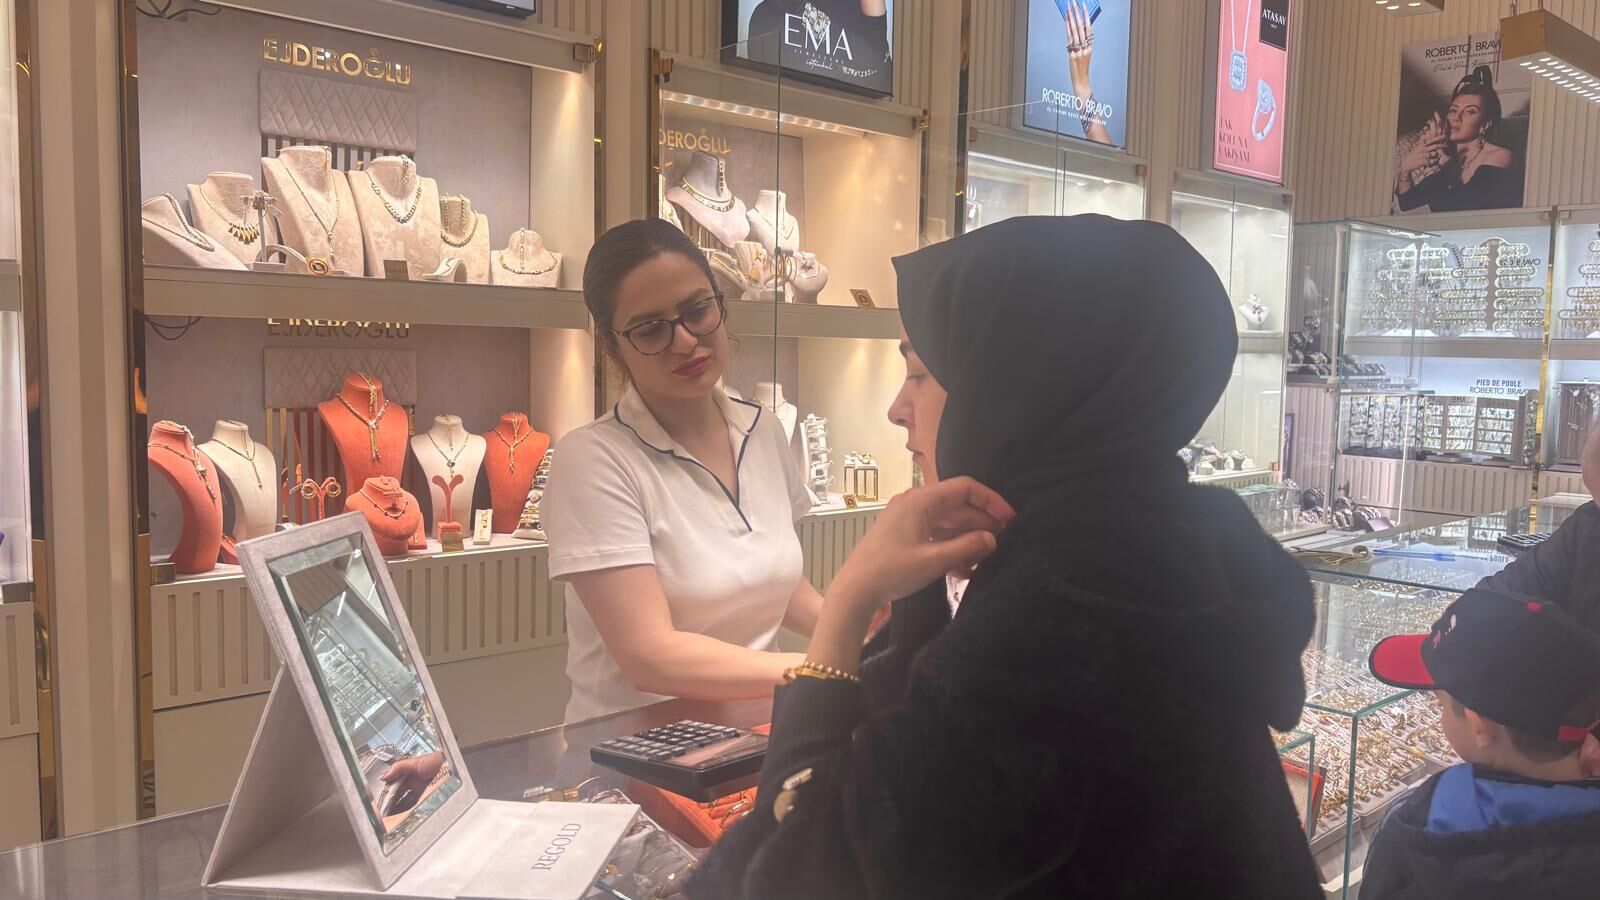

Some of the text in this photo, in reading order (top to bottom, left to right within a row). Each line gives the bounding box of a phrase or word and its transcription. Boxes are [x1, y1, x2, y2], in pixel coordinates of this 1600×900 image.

[1262, 8, 1287, 26] ATASAY
[784, 13, 853, 61] EMA
[1425, 43, 1471, 59] ROBERTO
[263, 37, 411, 85] EJDEROĞLU
[1042, 87, 1083, 111] ROBERTO
[1085, 96, 1113, 118] BRAVO
[1219, 116, 1233, 131] TAK
[1219, 131, 1248, 149] KOLUNA
[1469, 386, 1504, 395] ROBERTO
[1492, 379, 1500, 387] DE
[1501, 380, 1522, 388] POULE
[531, 823, 581, 870] REGOLD
